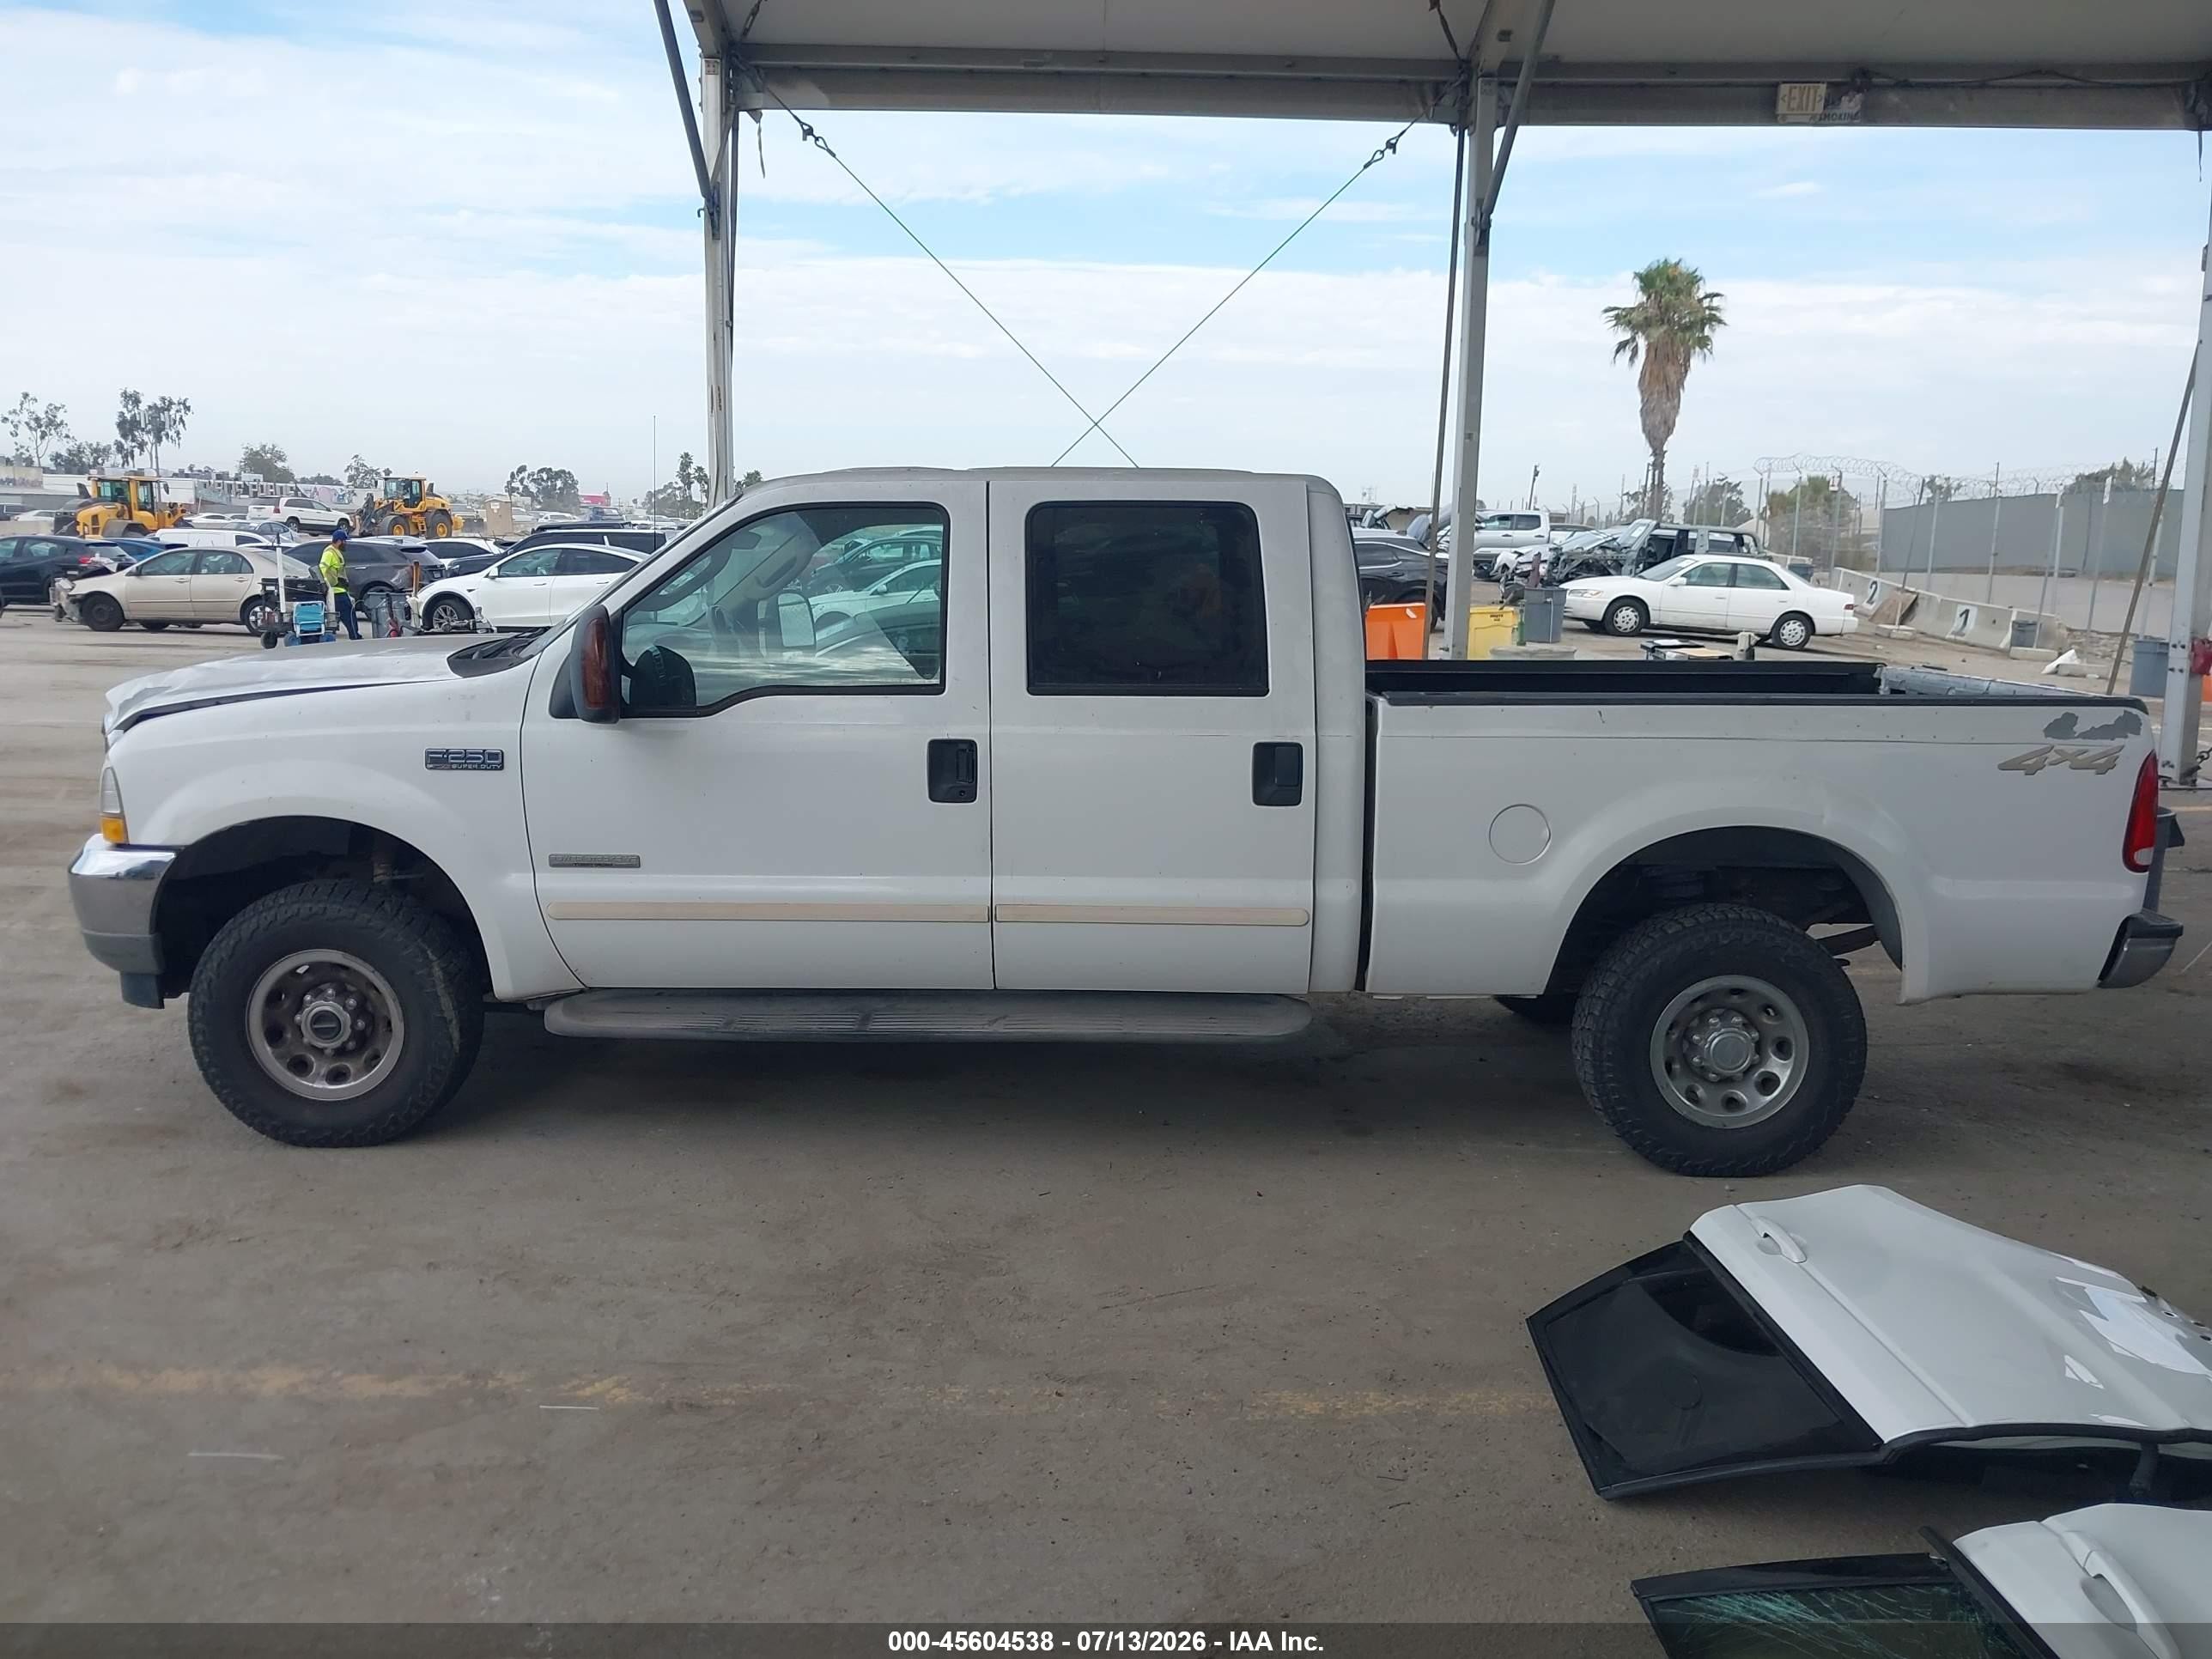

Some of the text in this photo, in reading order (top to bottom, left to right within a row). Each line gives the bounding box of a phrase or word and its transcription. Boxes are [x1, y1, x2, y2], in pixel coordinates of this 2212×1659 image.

[1786, 84, 1821, 112] EXIT
[1867, 580, 1879, 605] 2
[1953, 608, 1972, 636] 1
